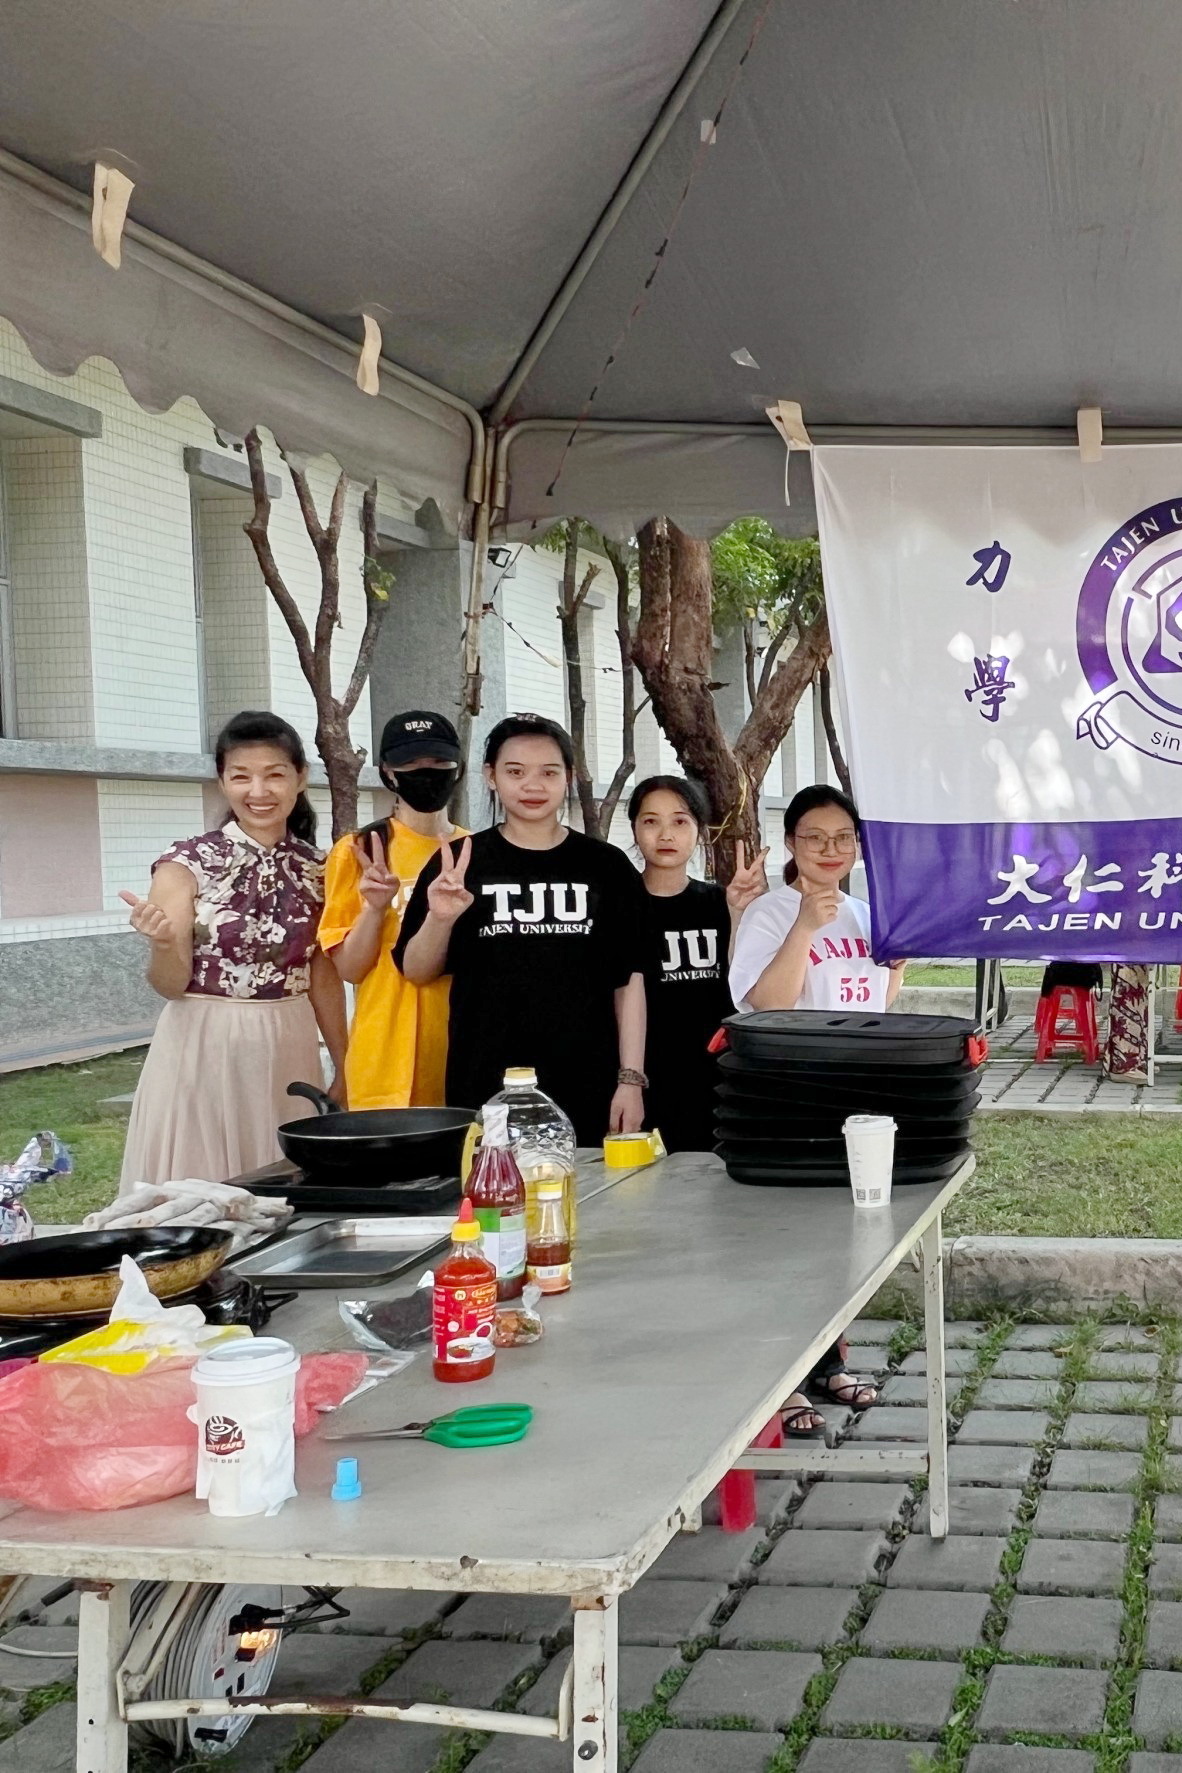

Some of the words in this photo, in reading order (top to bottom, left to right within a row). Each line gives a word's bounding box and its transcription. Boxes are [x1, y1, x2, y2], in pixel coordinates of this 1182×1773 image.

[1100, 516, 1161, 571] TAJEN
[481, 882, 589, 922] TJU
[978, 911, 1123, 931] TAJEN
[840, 977, 871, 1003] 55
